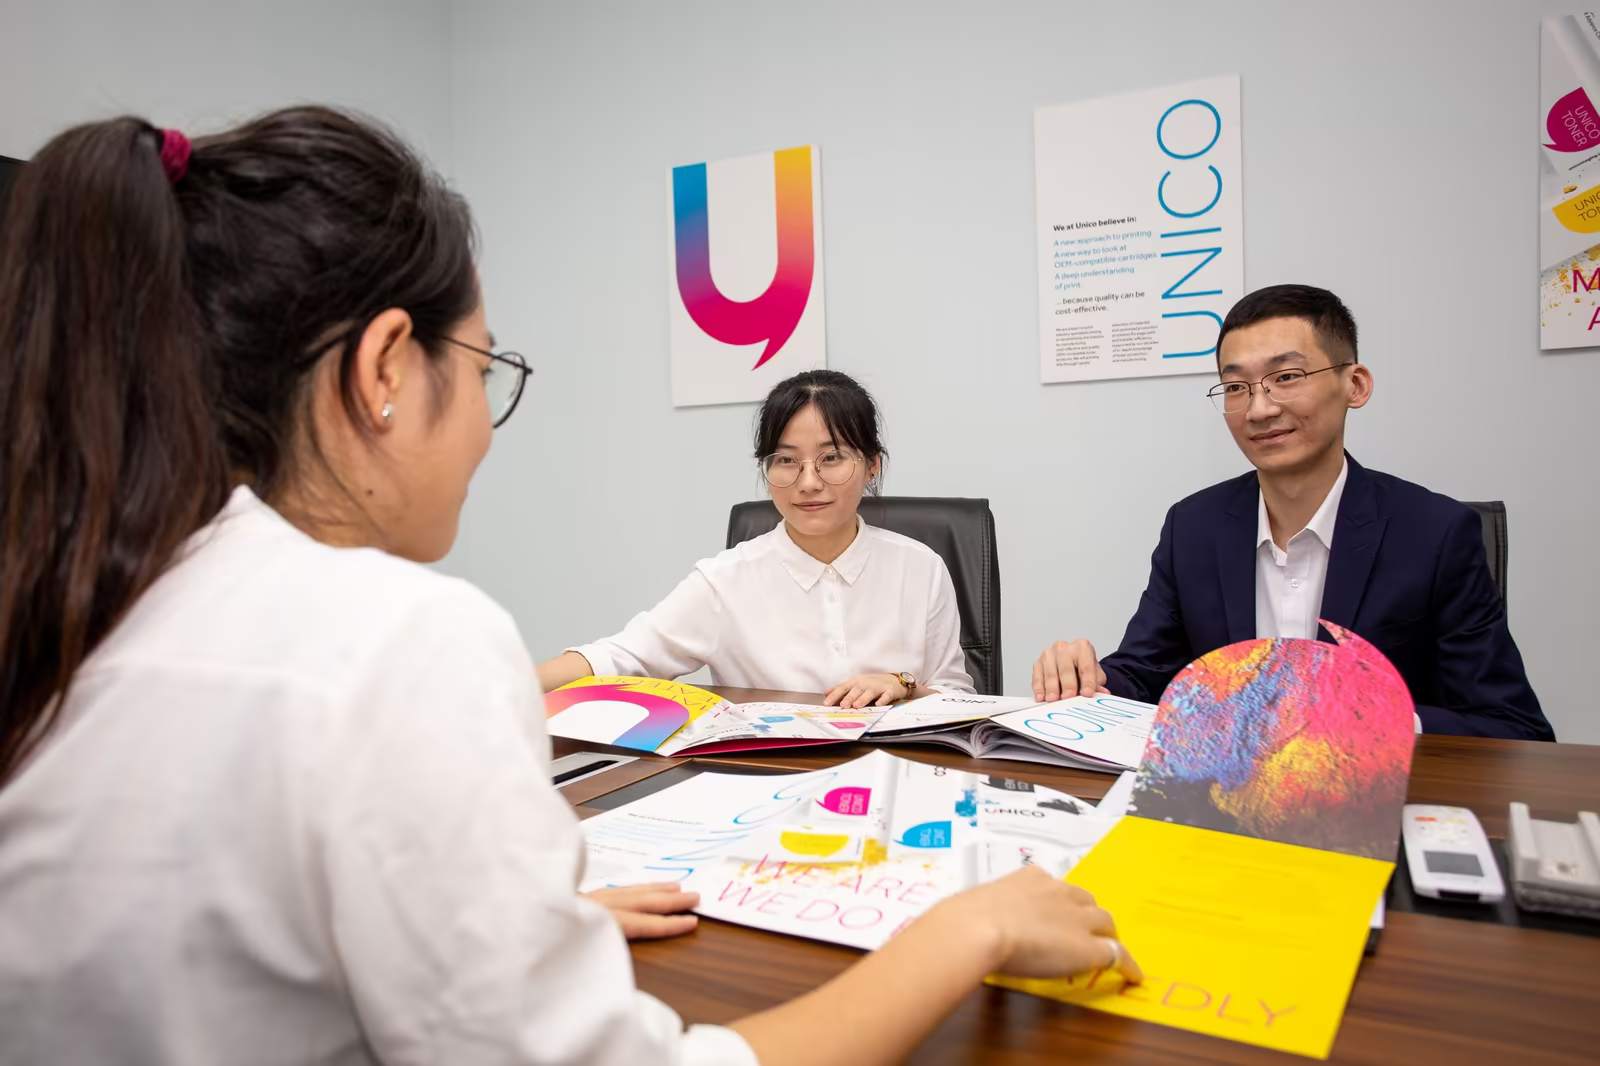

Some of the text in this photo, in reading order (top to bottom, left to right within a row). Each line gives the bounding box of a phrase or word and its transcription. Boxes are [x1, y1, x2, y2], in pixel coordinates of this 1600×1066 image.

[1561, 110, 1588, 147] TONER
[1575, 105, 1600, 139] UNICO
[1075, 221, 1097, 230] Unico
[1098, 217, 1126, 227] believe
[1157, 99, 1223, 359] UNICO
[1094, 291, 1119, 303] quality
[1120, 291, 1134, 299] can
[1135, 290, 1145, 298] be
